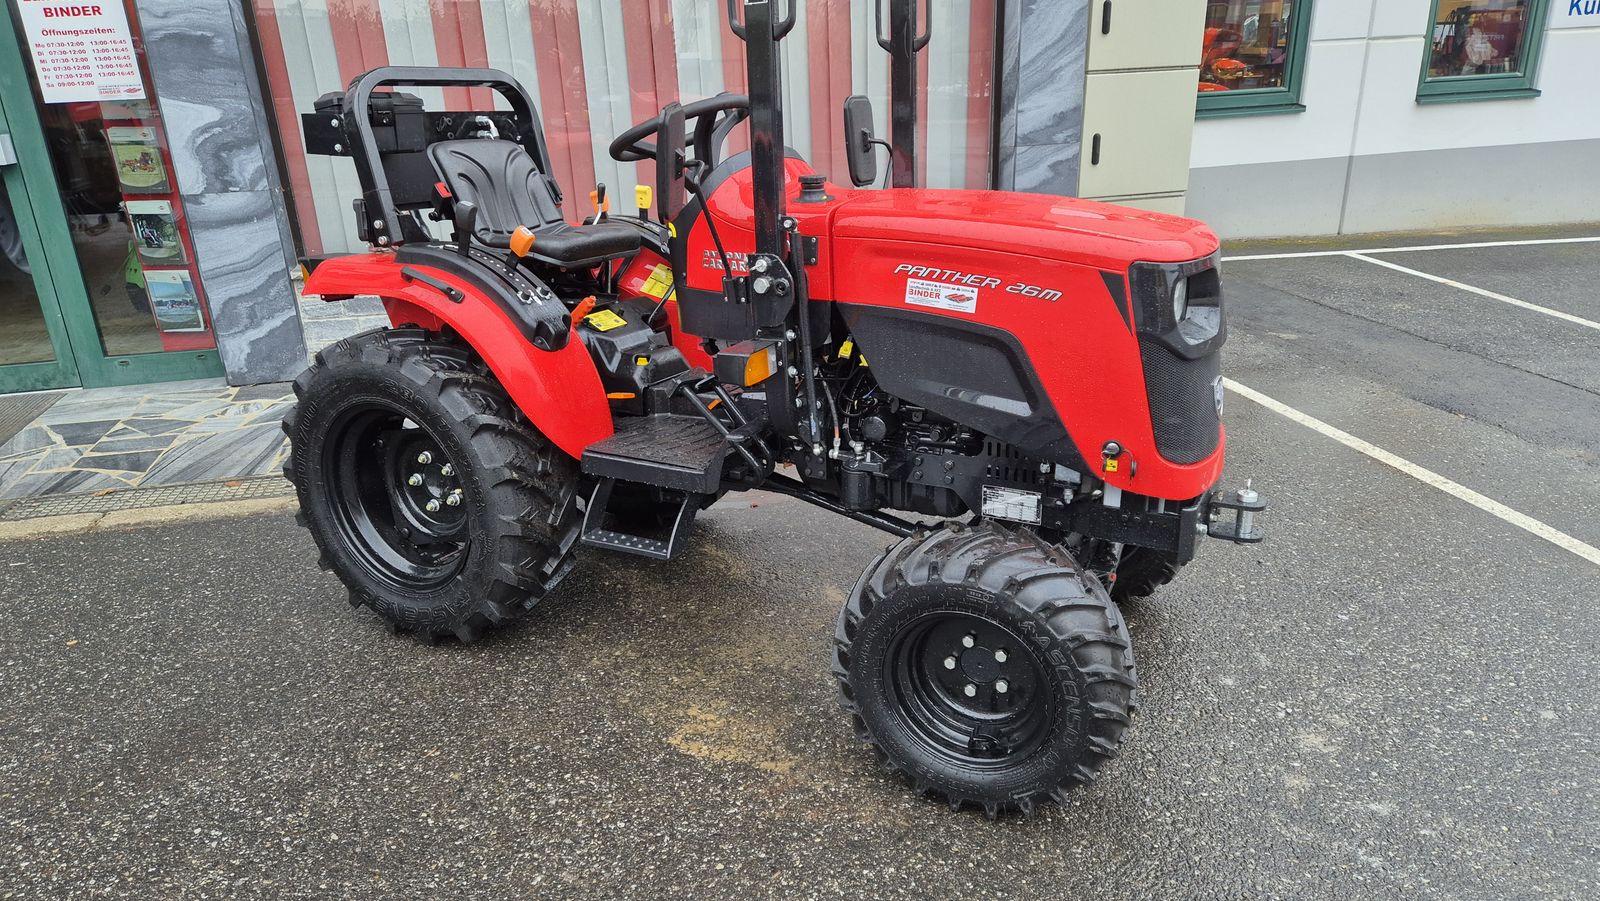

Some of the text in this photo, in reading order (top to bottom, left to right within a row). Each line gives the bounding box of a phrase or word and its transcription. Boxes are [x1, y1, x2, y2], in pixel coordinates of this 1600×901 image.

[43, 6, 102, 17] BINDER
[1568, 0, 1600, 16] Ku
[41, 28, 115, 37] Öffnungszeiten:
[894, 263, 1002, 289] PANTHER
[908, 288, 941, 299] BINDER
